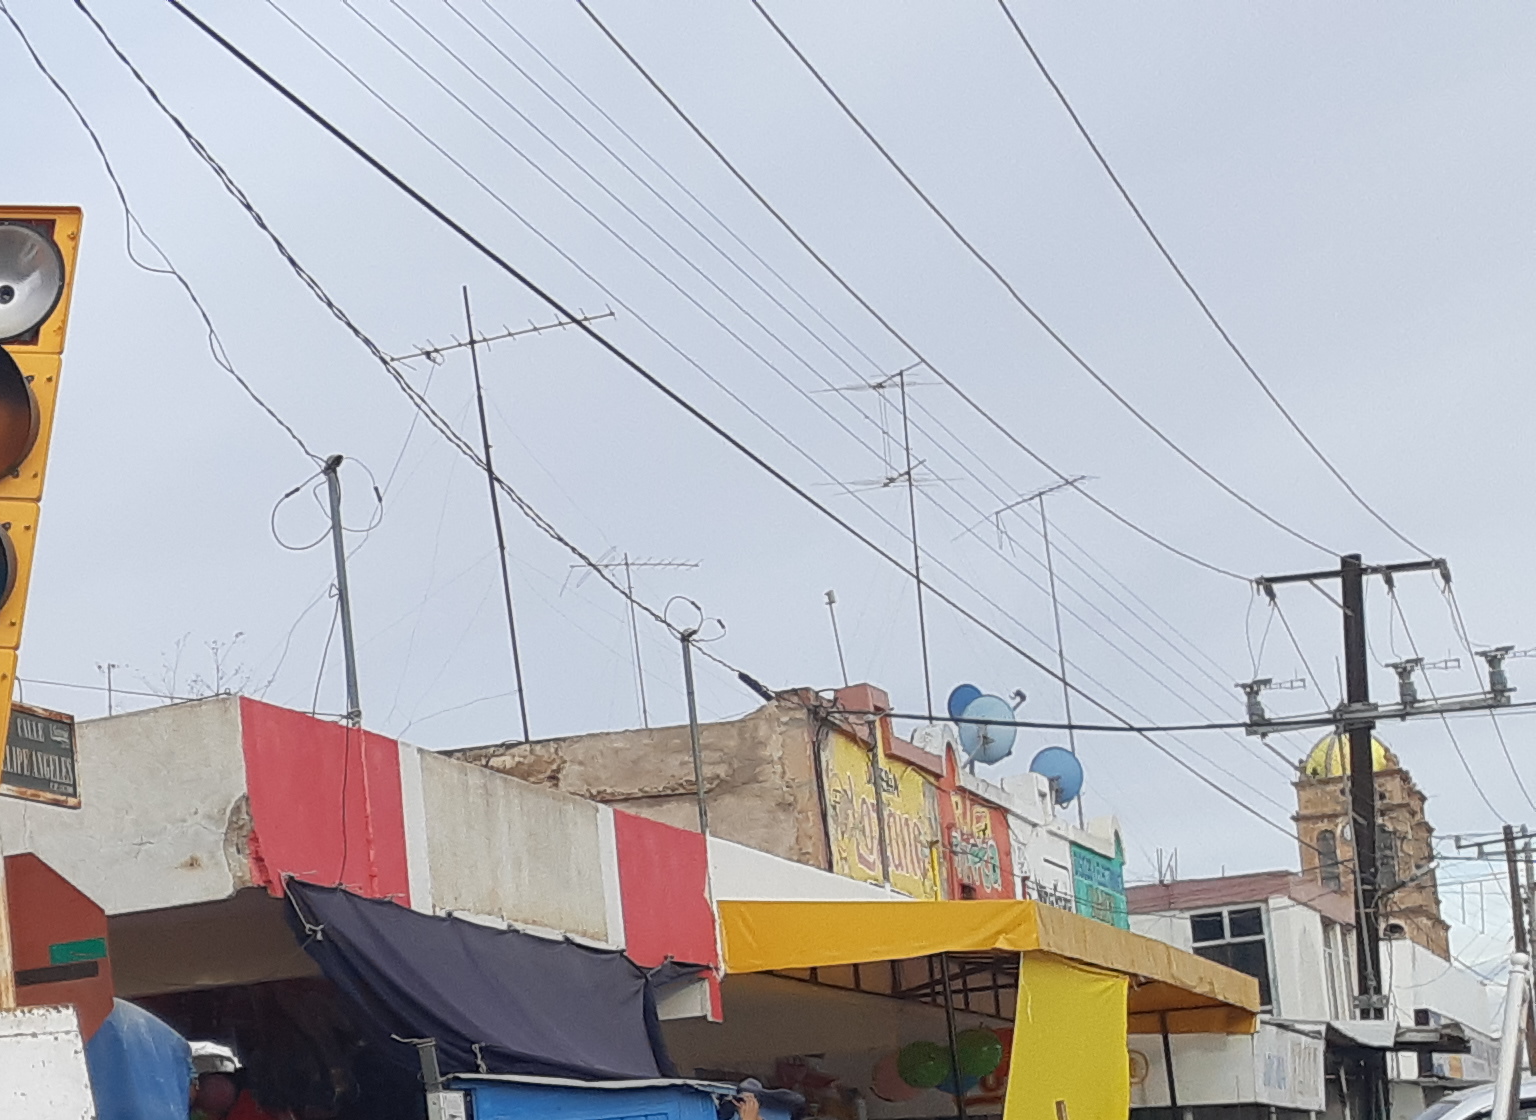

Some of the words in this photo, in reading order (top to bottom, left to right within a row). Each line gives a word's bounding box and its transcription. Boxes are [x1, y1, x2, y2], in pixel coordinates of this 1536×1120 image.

[16, 716, 46, 743] CALLE
[3, 744, 30, 777] LIPE
[31, 748, 74, 785] ANGELES
